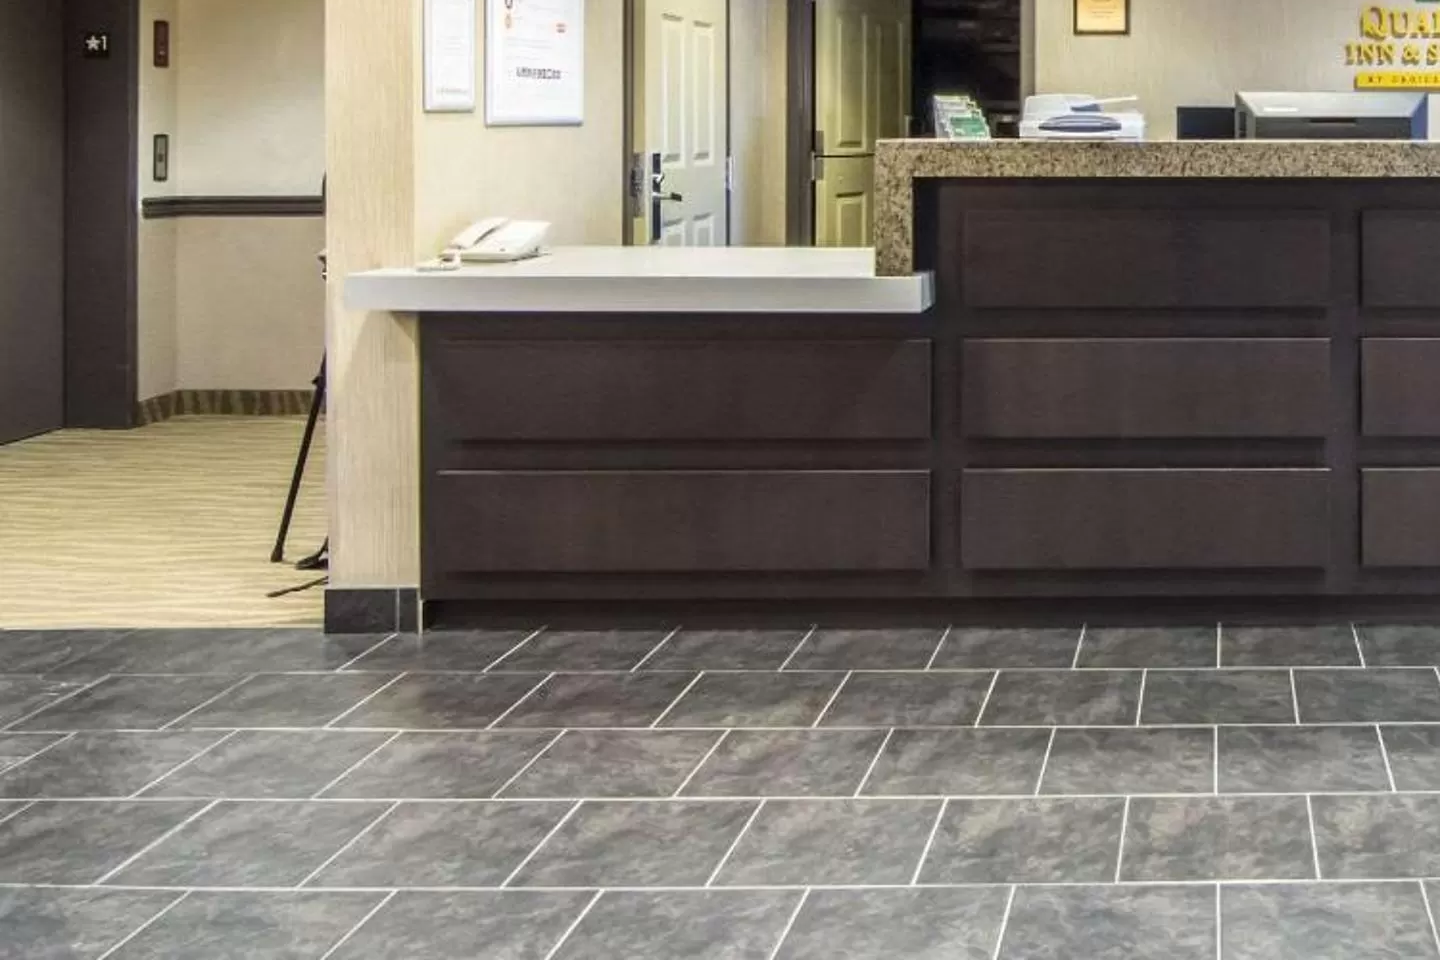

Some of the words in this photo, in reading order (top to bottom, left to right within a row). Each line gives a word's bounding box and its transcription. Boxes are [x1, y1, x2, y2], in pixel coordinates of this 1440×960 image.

[101, 35, 107, 51] 1
[1345, 43, 1396, 66] INN
[1401, 43, 1420, 66] &
